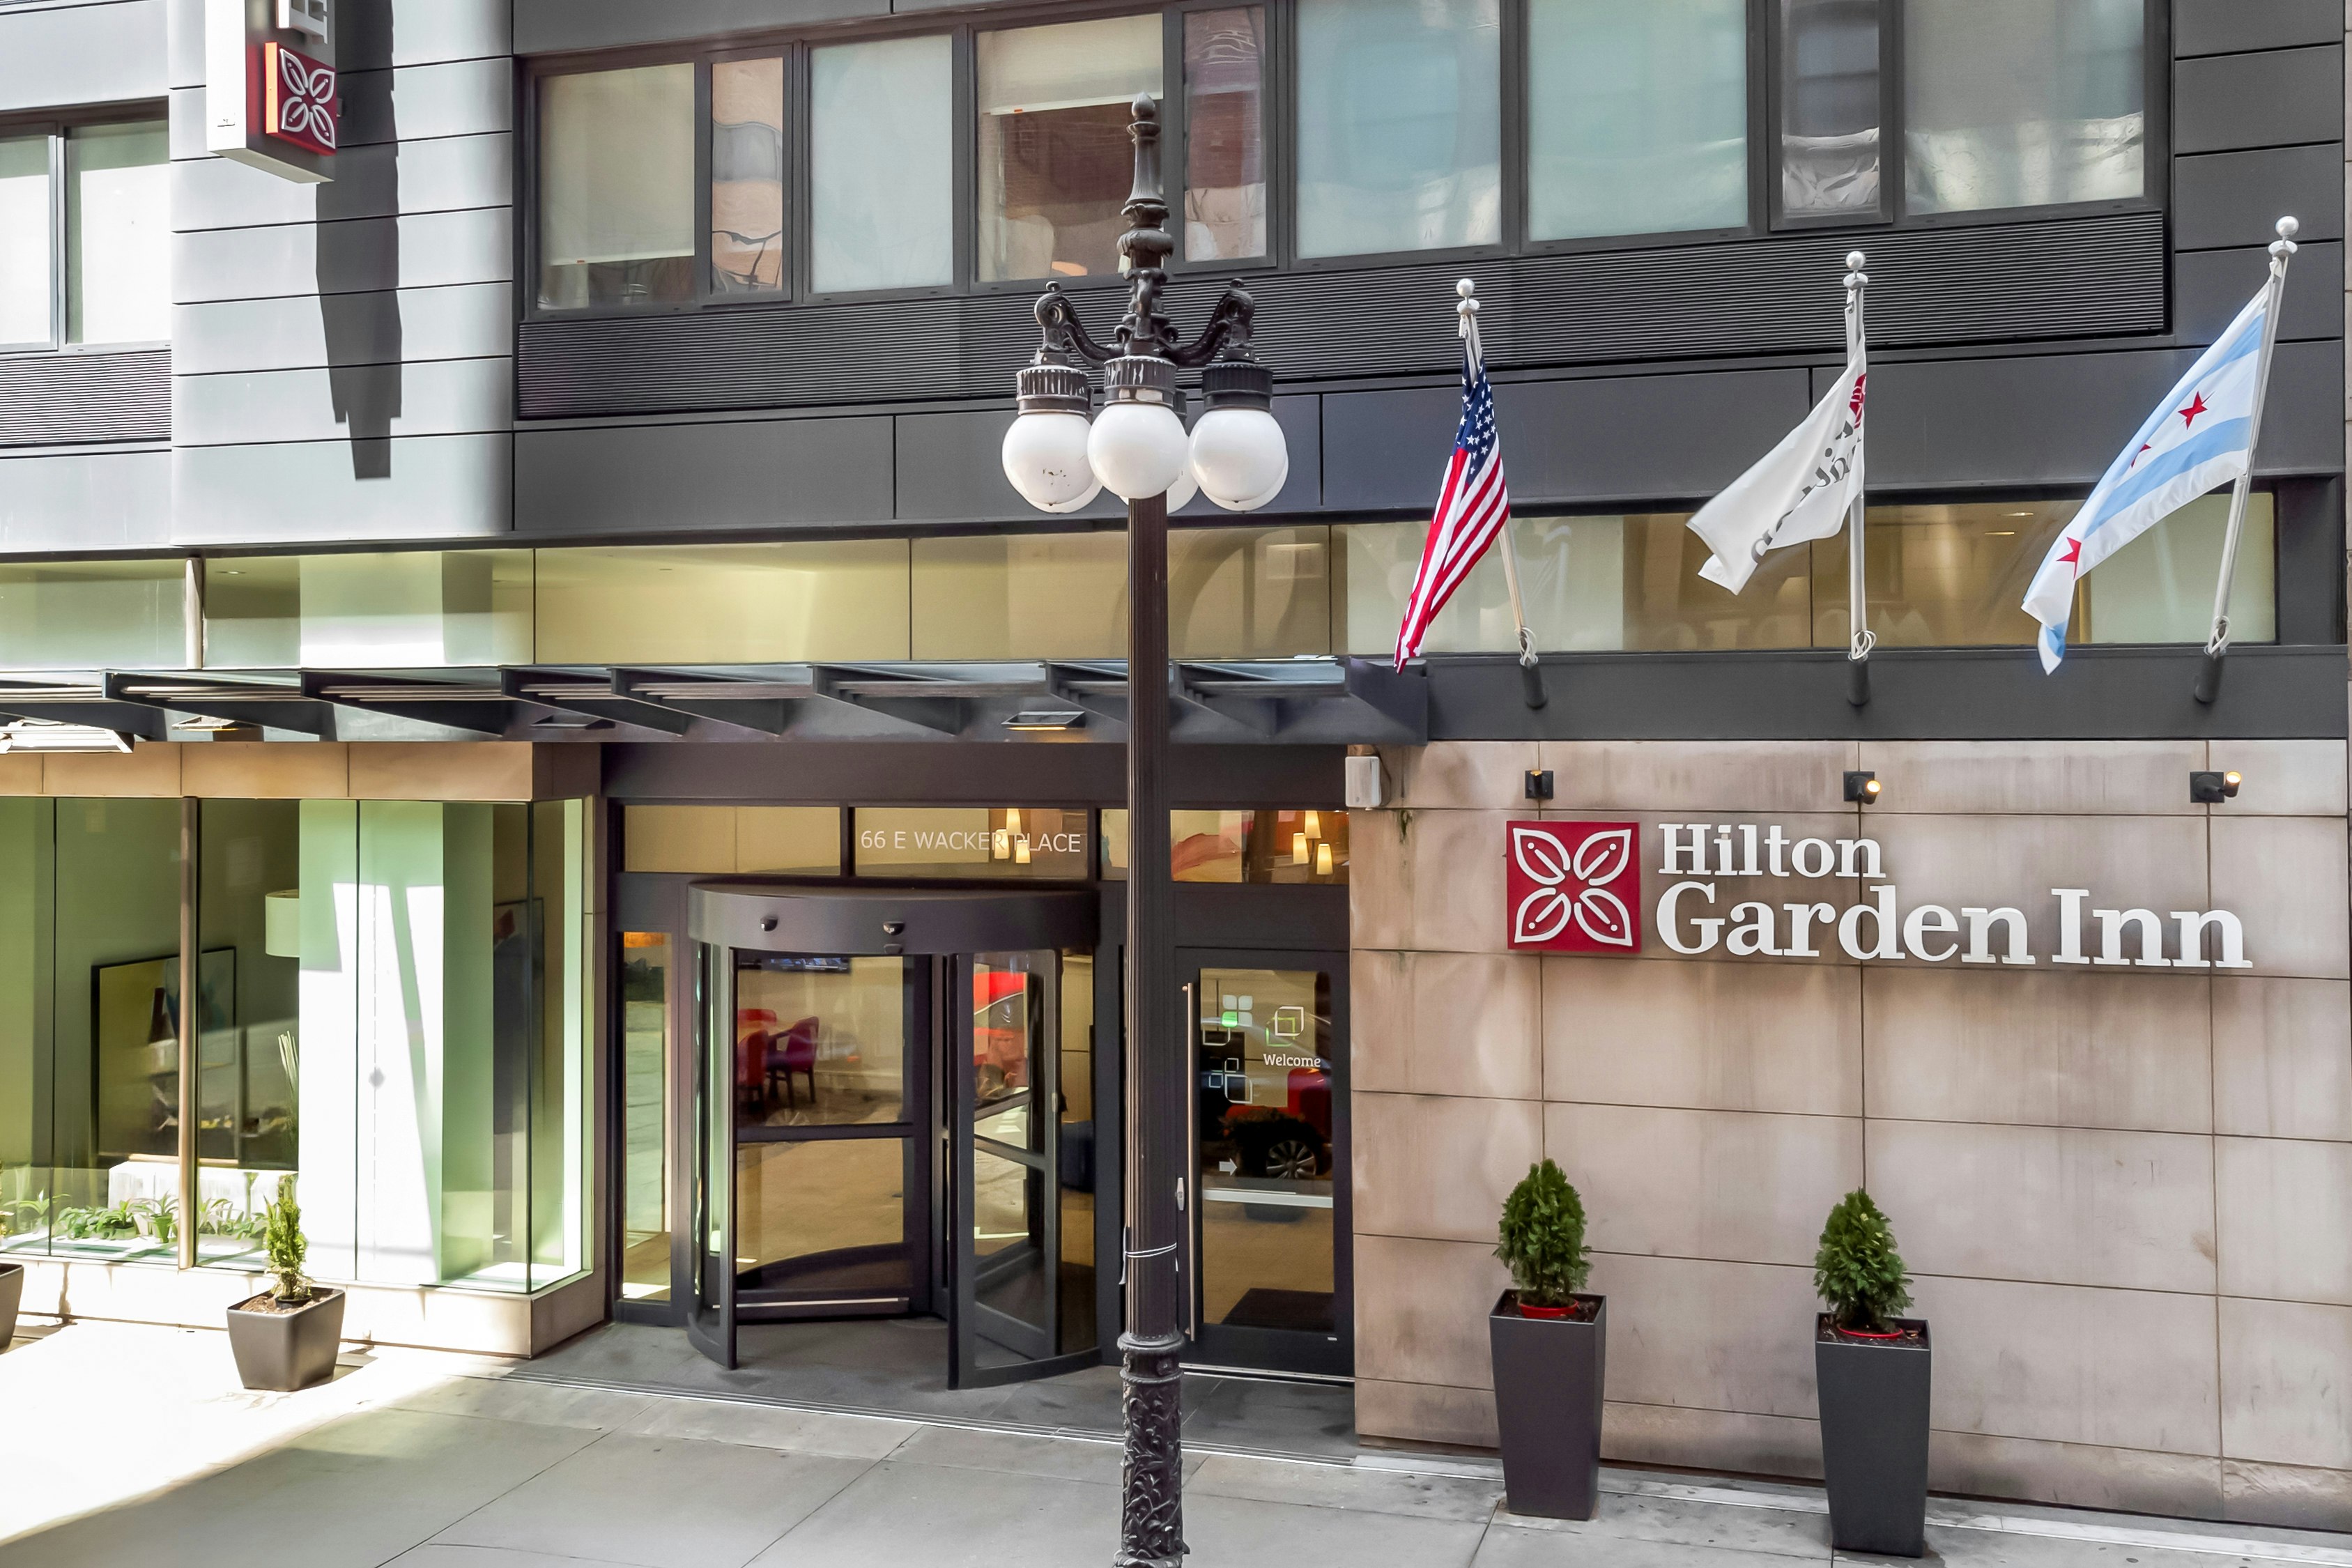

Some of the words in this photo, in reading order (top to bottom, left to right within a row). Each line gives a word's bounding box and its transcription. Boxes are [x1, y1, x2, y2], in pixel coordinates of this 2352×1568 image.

[861, 830, 886, 849] 66
[894, 831, 906, 849] E
[914, 831, 1005, 851] WACKER
[1014, 833, 1081, 852] PLACE
[1658, 823, 1886, 879] Hilton
[1656, 881, 2036, 965] Garden
[2051, 888, 2253, 969] Inn
[1263, 1053, 1321, 1068] Welcome
